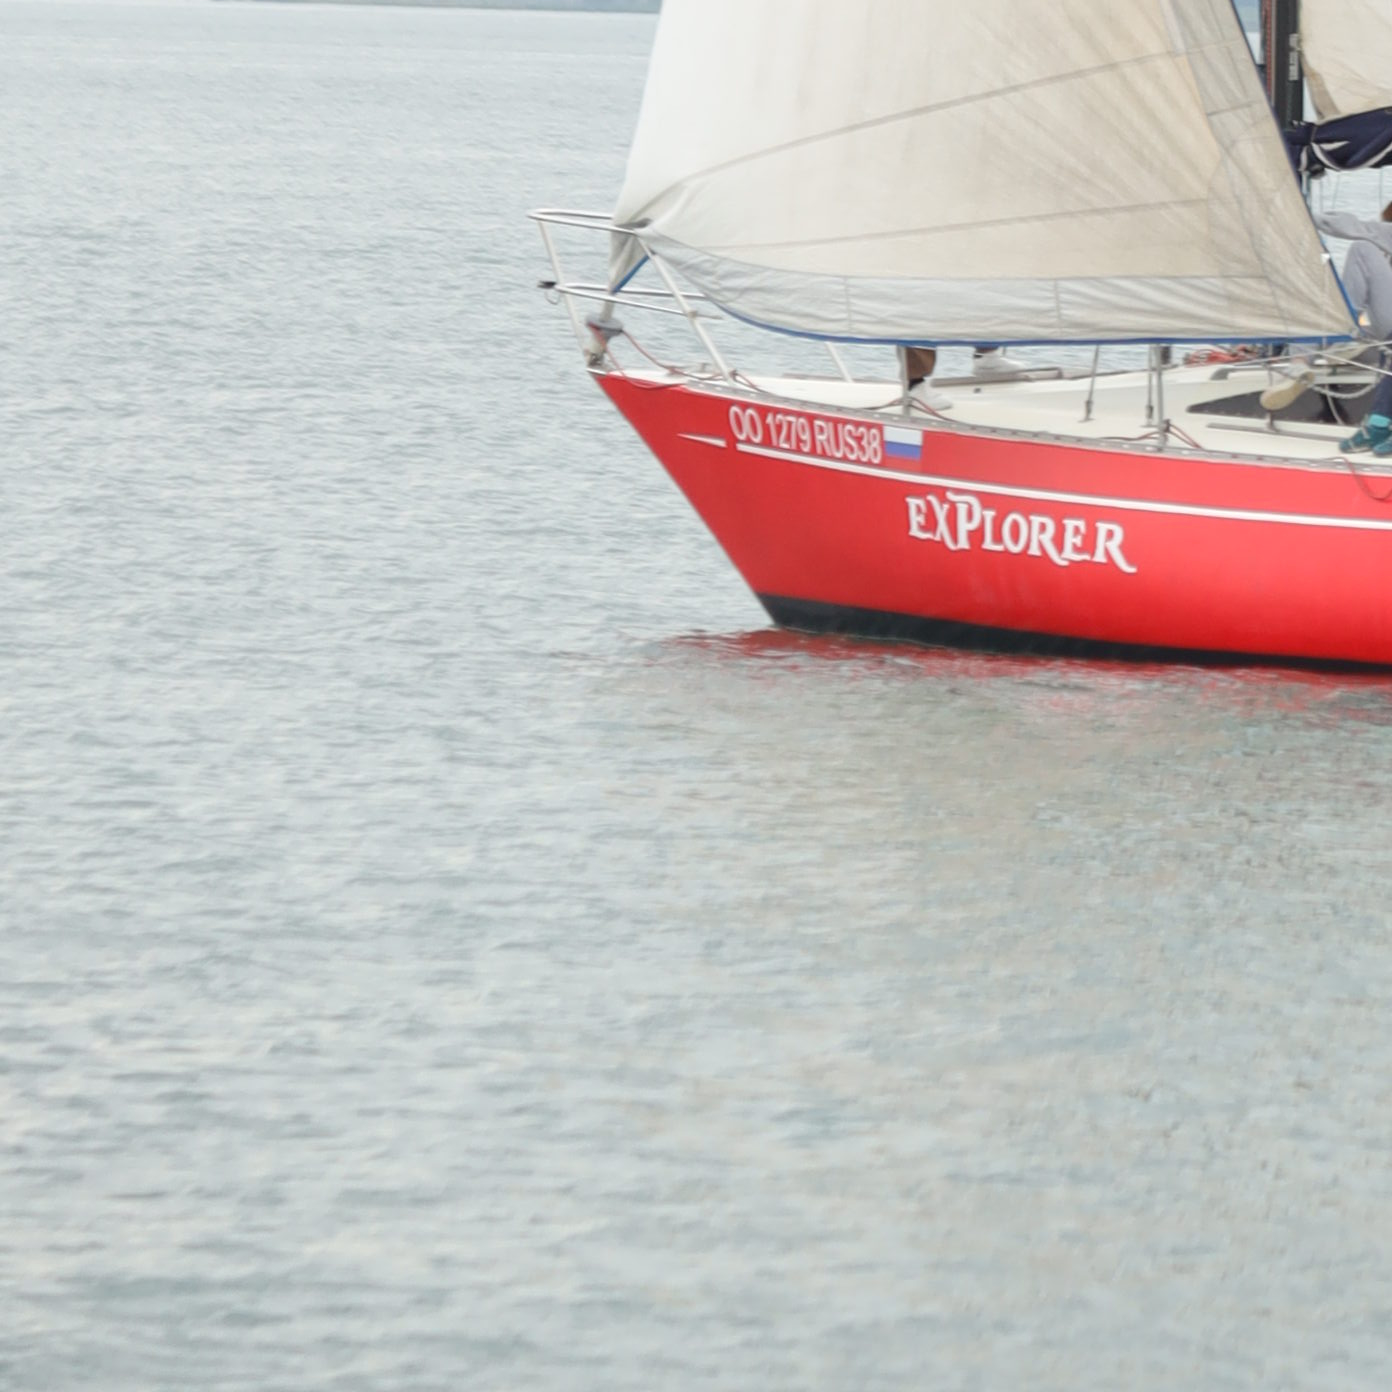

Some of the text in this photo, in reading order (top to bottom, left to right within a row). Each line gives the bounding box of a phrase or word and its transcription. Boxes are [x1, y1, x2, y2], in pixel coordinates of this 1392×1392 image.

[766, 414, 810, 452] 1279
[813, 420, 881, 464] RUS38
[905, 491, 1137, 573] EXPLORER
